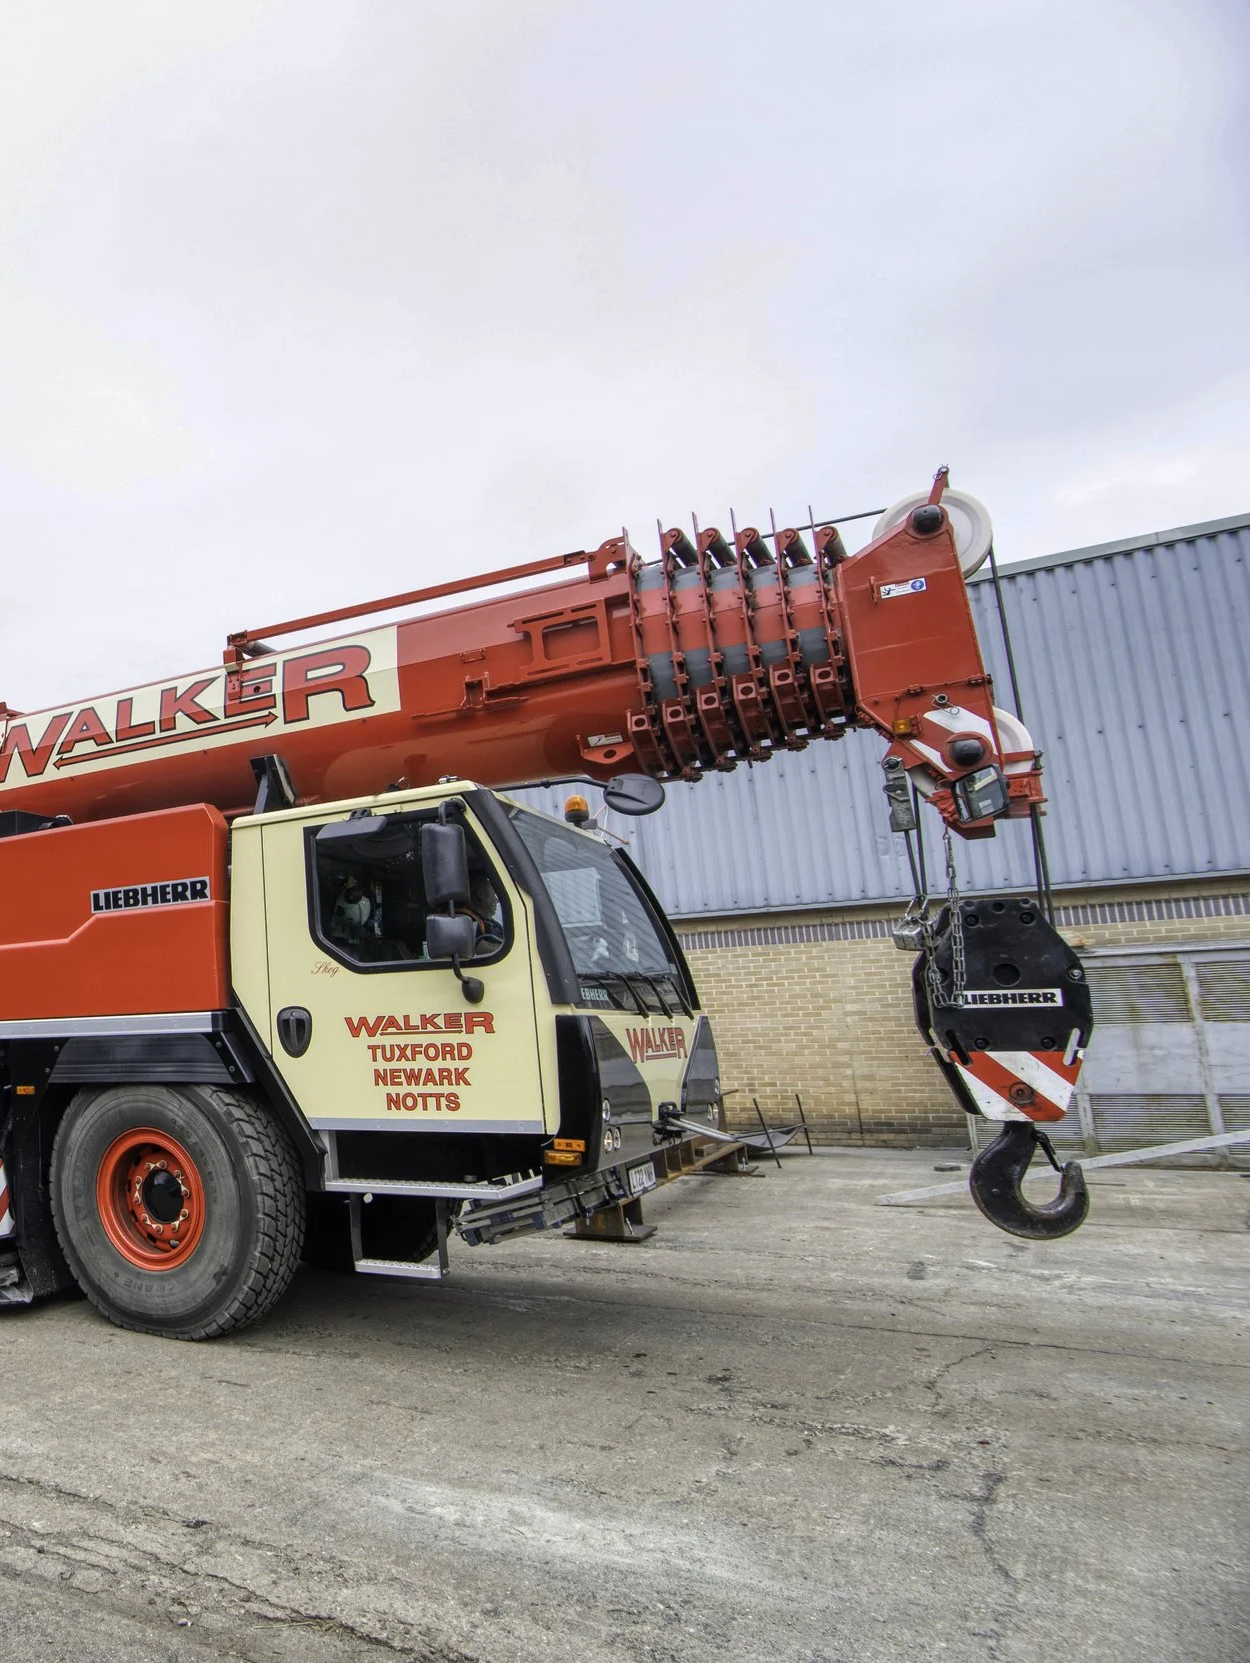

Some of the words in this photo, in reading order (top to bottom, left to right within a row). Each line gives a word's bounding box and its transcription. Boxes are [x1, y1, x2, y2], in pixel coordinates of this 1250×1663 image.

[93, 879, 208, 911] LIEBHERR
[580, 987, 609, 1001] EBHERR
[962, 992, 1058, 1005] LIEBHERR
[344, 1011, 496, 1038] WALKER
[367, 1042, 473, 1062] TUXFORD
[625, 1027, 688, 1064] WALKER
[373, 1067, 471, 1086] NEWARK
[386, 1092, 461, 1111] NOTTS
